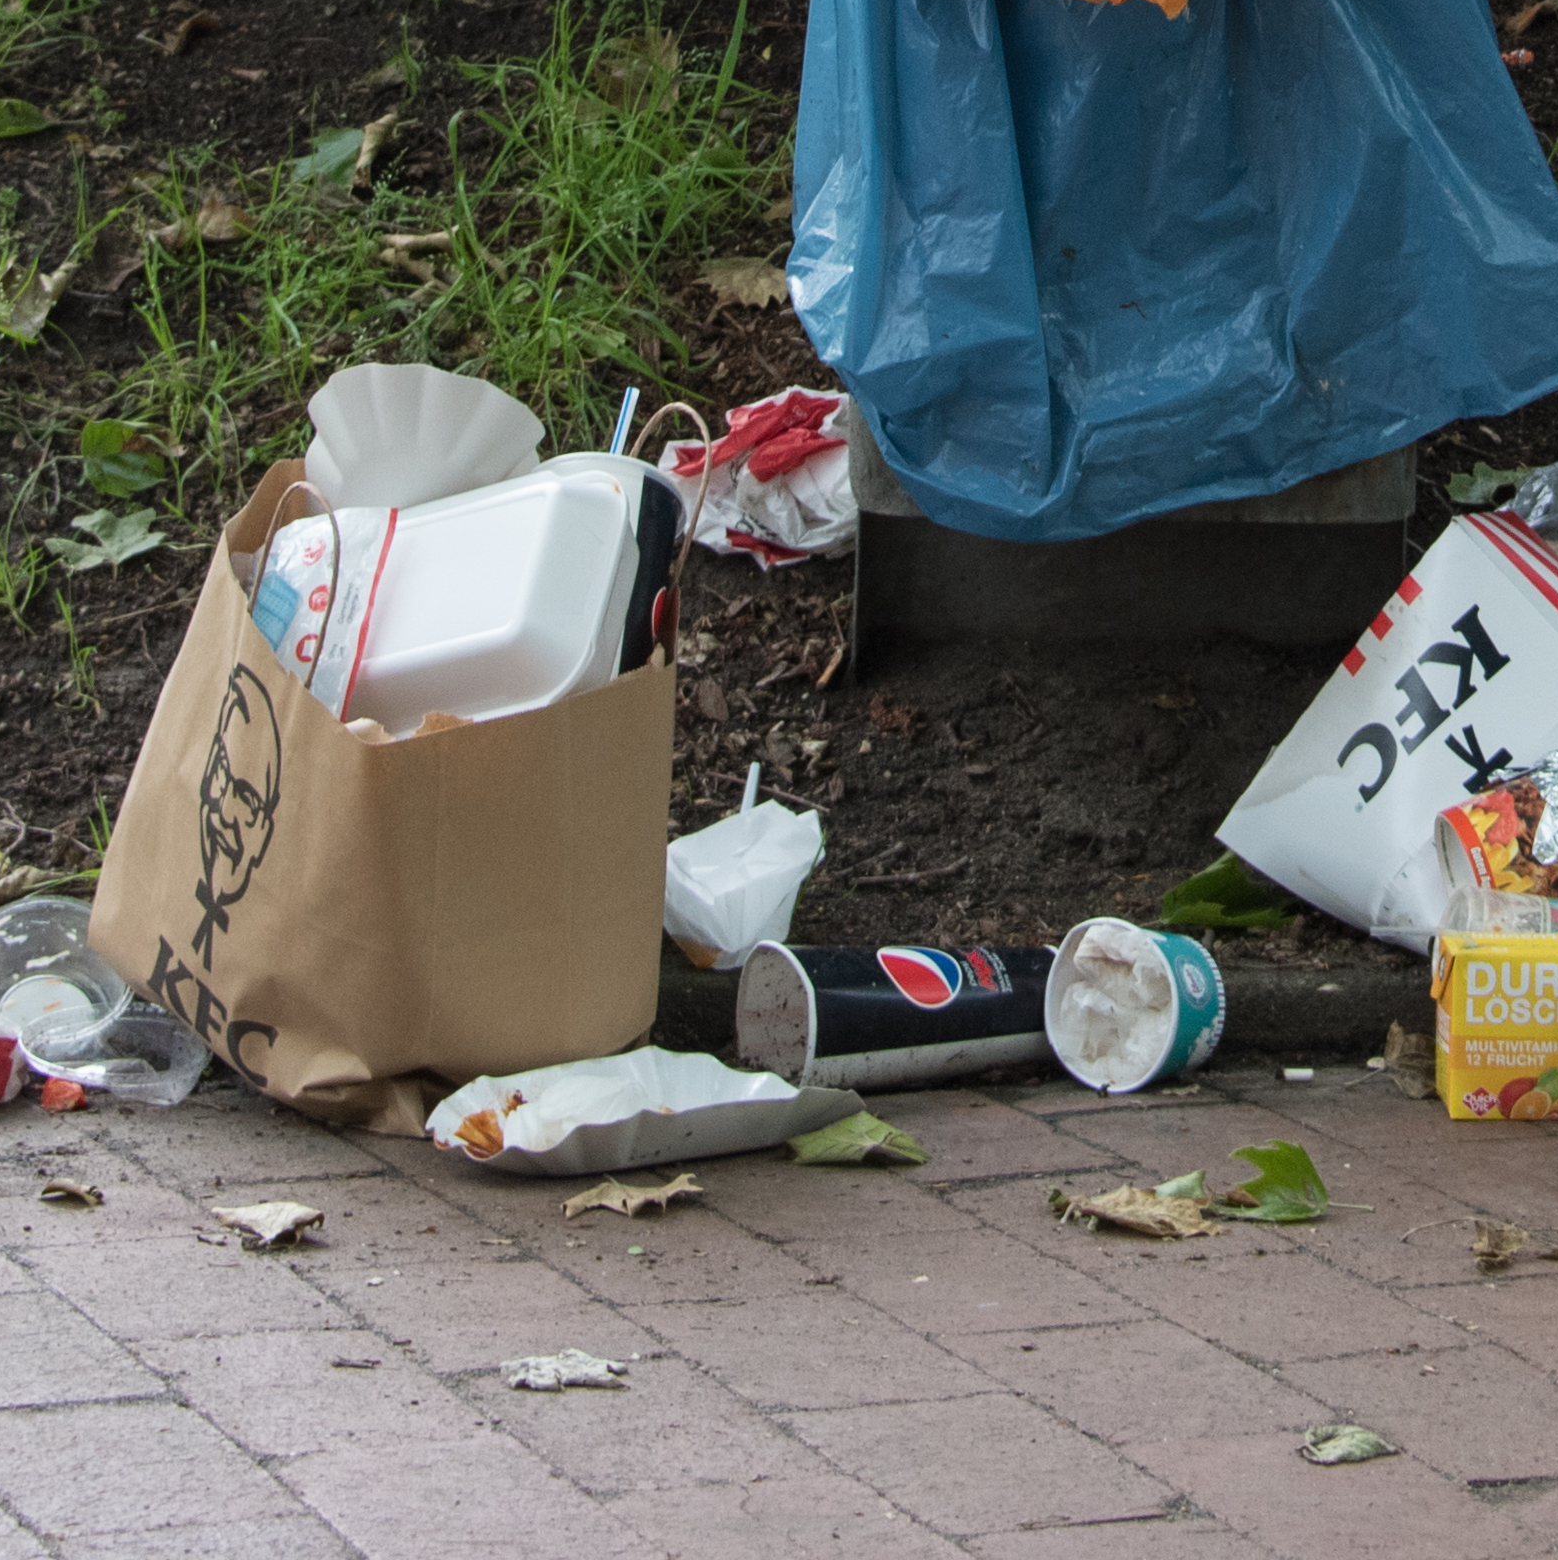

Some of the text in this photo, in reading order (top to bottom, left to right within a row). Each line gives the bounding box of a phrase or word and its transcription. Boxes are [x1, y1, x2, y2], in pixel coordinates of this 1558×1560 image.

[1337, 603, 1511, 804] KFC
[146, 934, 280, 1089] KFC
[1466, 1054, 1547, 1066] 12 FRUCHT
